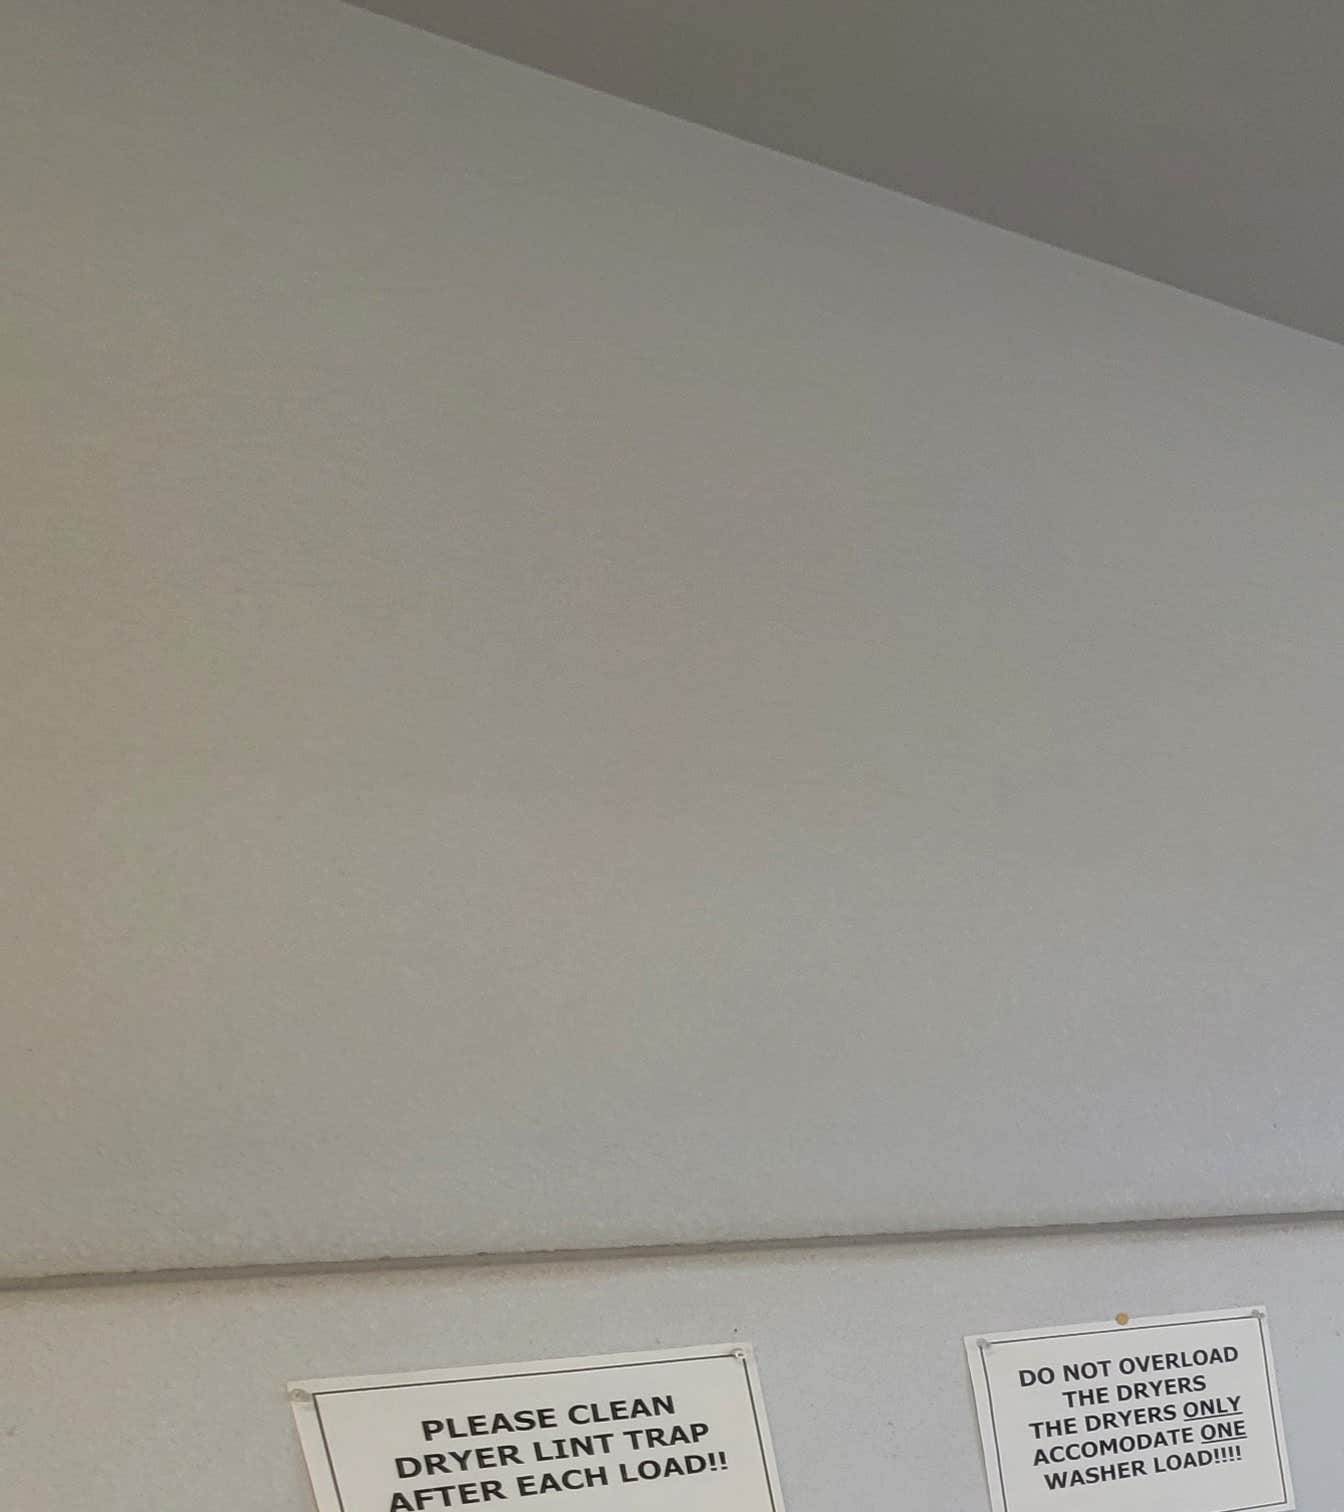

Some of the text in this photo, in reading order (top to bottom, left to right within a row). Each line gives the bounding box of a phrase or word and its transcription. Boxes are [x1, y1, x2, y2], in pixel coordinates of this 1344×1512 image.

[1018, 1346, 1238, 1387] DO NOT OVERLOAD
[1062, 1375, 1207, 1408] THE DRYERS
[421, 1395, 676, 1441] PLEASE CLEAN
[1029, 1395, 1243, 1440] THE DRYERS ONLY
[395, 1422, 709, 1479] DRYER LINT TRAP
[1033, 1420, 1248, 1466] ACCOMODATE ONE
[516, 1466, 608, 1497] EACH
[619, 1451, 729, 1483] LOAD!!
[1044, 1445, 1243, 1491] WASHER LOAD!!!!
